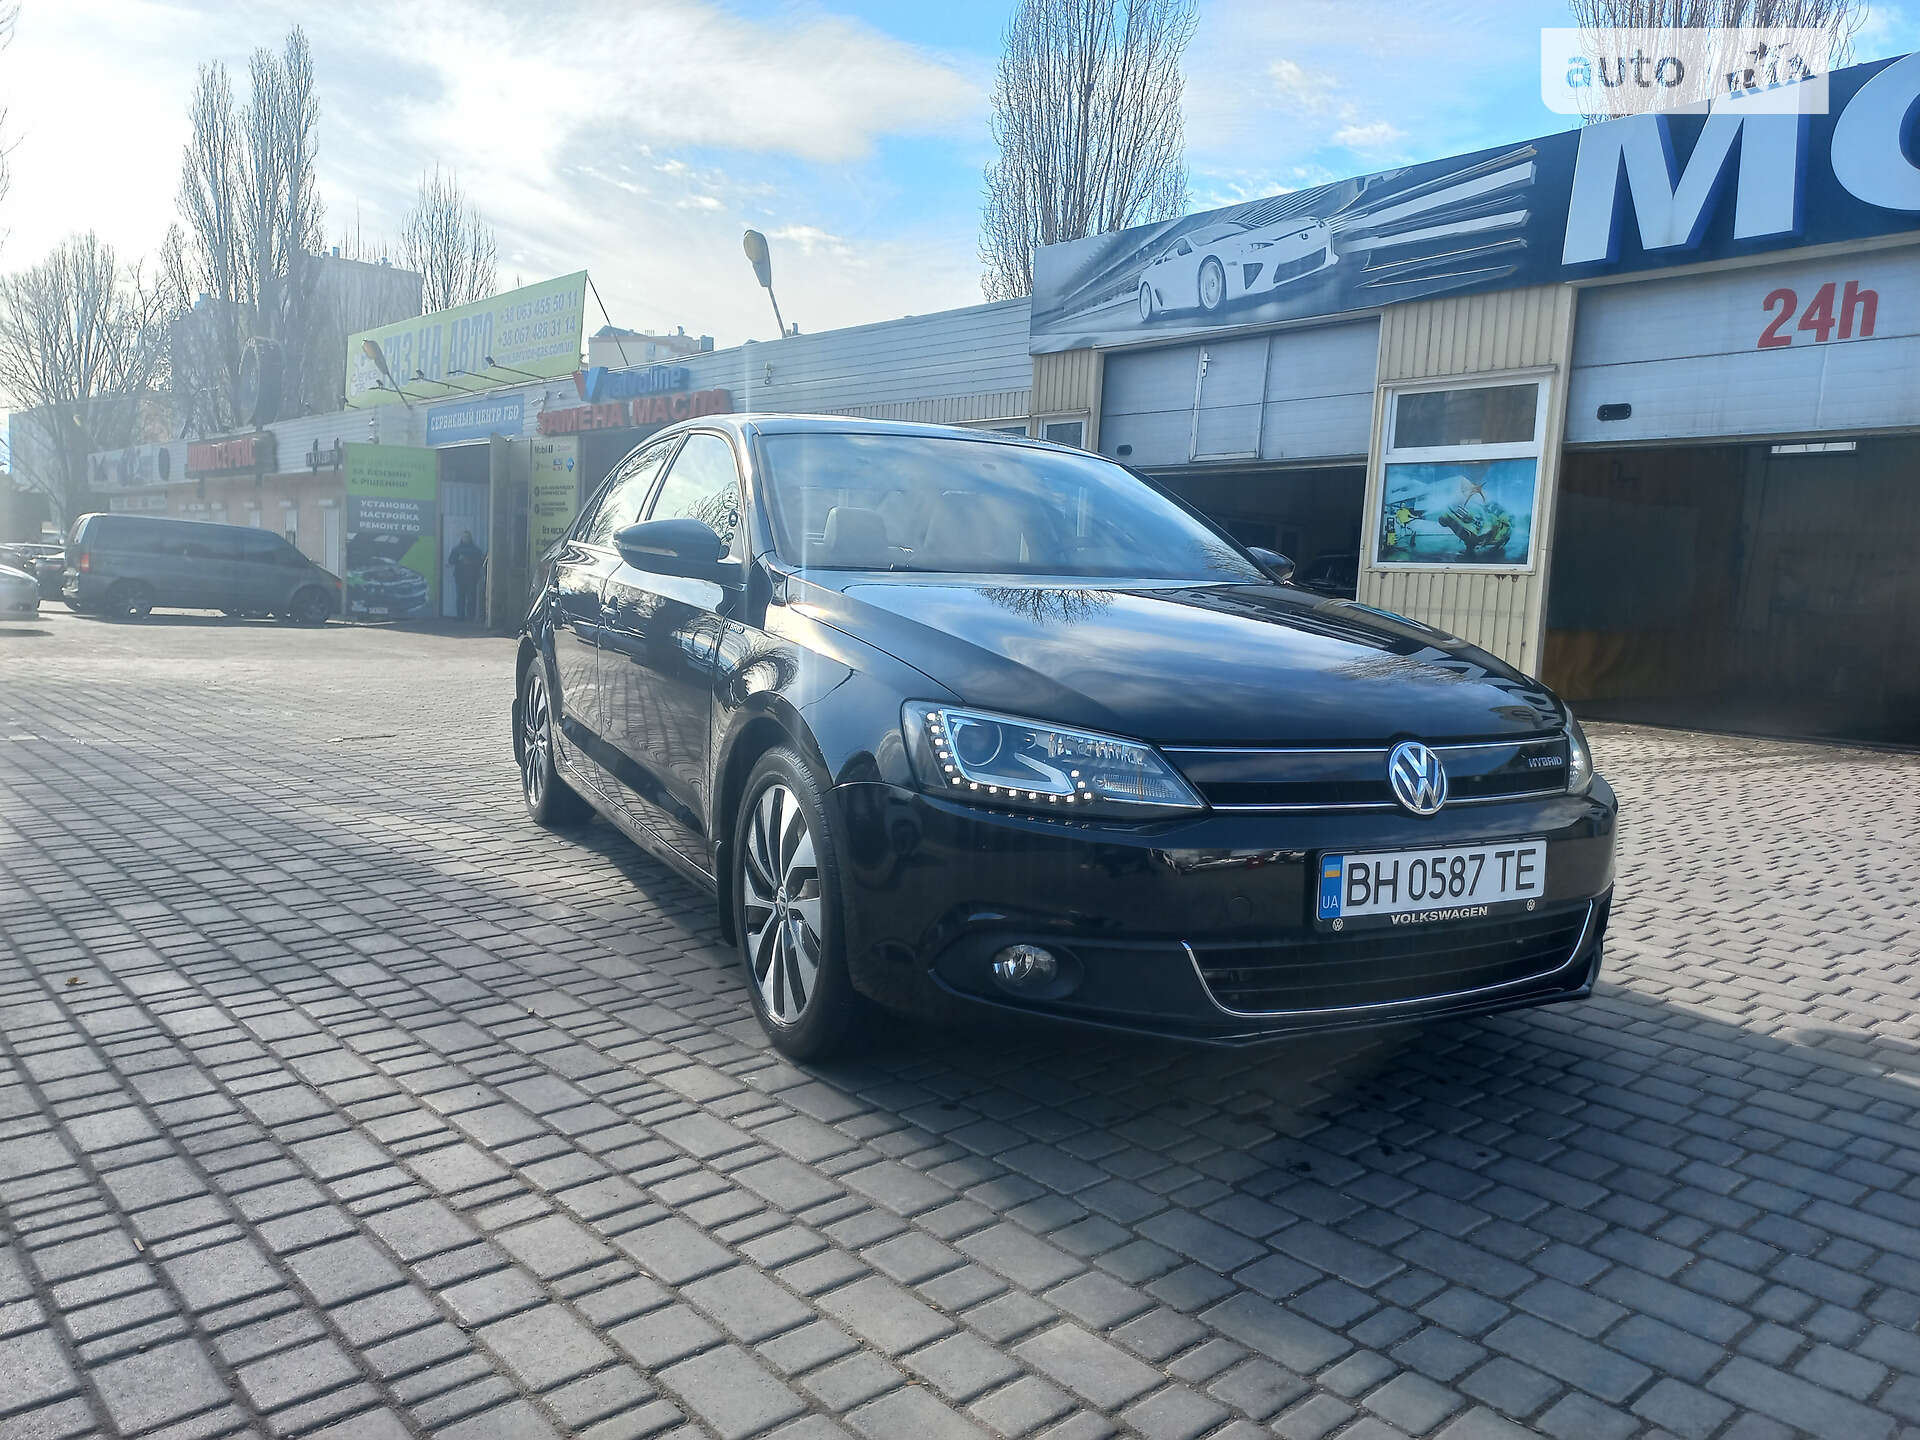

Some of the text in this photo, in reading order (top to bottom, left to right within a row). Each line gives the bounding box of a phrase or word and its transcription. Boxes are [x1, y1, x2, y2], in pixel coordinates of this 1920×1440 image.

[567, 288, 578, 309] 11
[1756, 280, 1879, 349] 24h
[550, 318, 561, 336] 31
[565, 315, 576, 333] 14
[417, 323, 443, 380] НА
[447, 311, 494, 377] АВТО
[537, 389, 731, 435] ЗАМЕНА МАСЛА
[359, 510, 420, 521] НАСТРОЙКА
[360, 499, 419, 511] УСТАНОВКА
[359, 520, 399, 531] РЕМОНТ
[1527, 755, 1563, 768] HYBRID
[1345, 848, 1537, 907] BH 0587 TE
[1321, 895, 1339, 909] UA
[1390, 905, 1488, 926] VOLKSWAGEN
